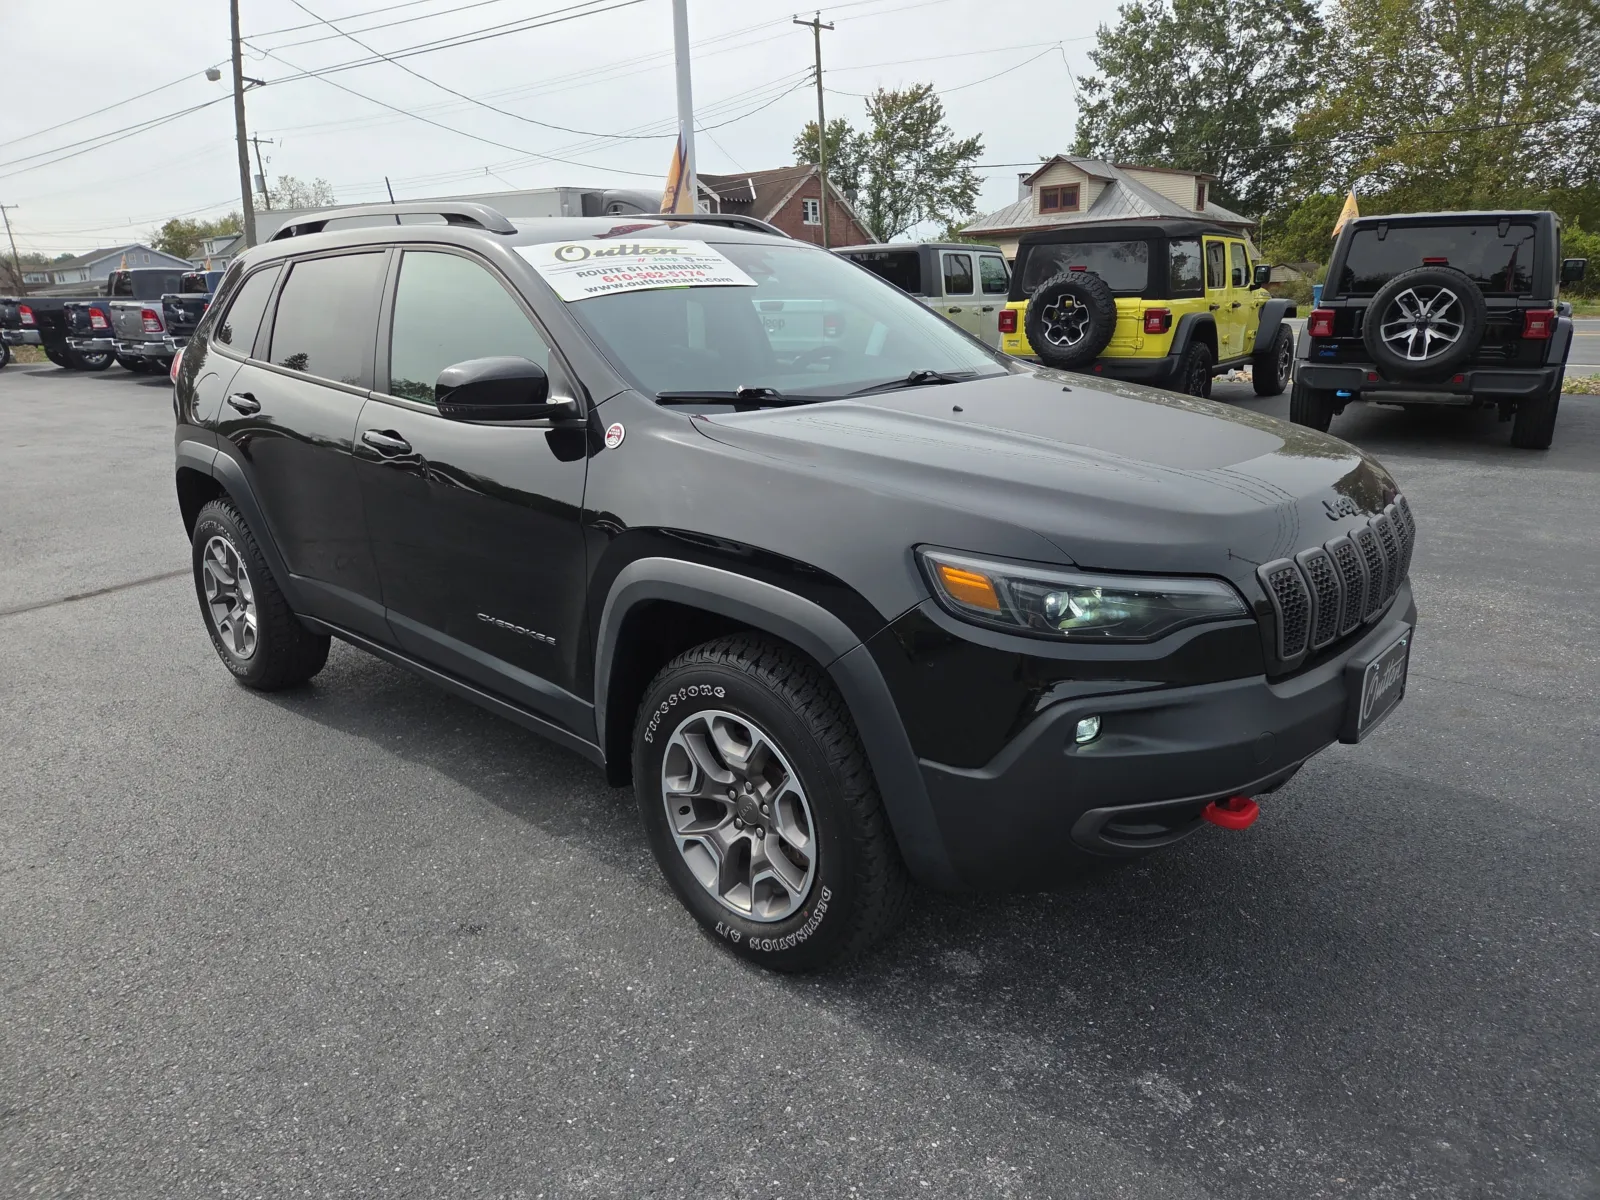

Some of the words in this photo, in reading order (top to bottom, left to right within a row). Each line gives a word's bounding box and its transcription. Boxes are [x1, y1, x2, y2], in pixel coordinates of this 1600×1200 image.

[554, 243, 696, 262] Outten
[576, 266, 625, 278] ROUTE
[602, 269, 706, 283] 610-562-5174
[584, 276, 734, 293] www.outtencars.com
[1321, 496, 1361, 521] Jeep
[644, 684, 726, 744] Firestone
[749, 885, 833, 952] DESTINATION
[714, 921, 742, 943] A/T
